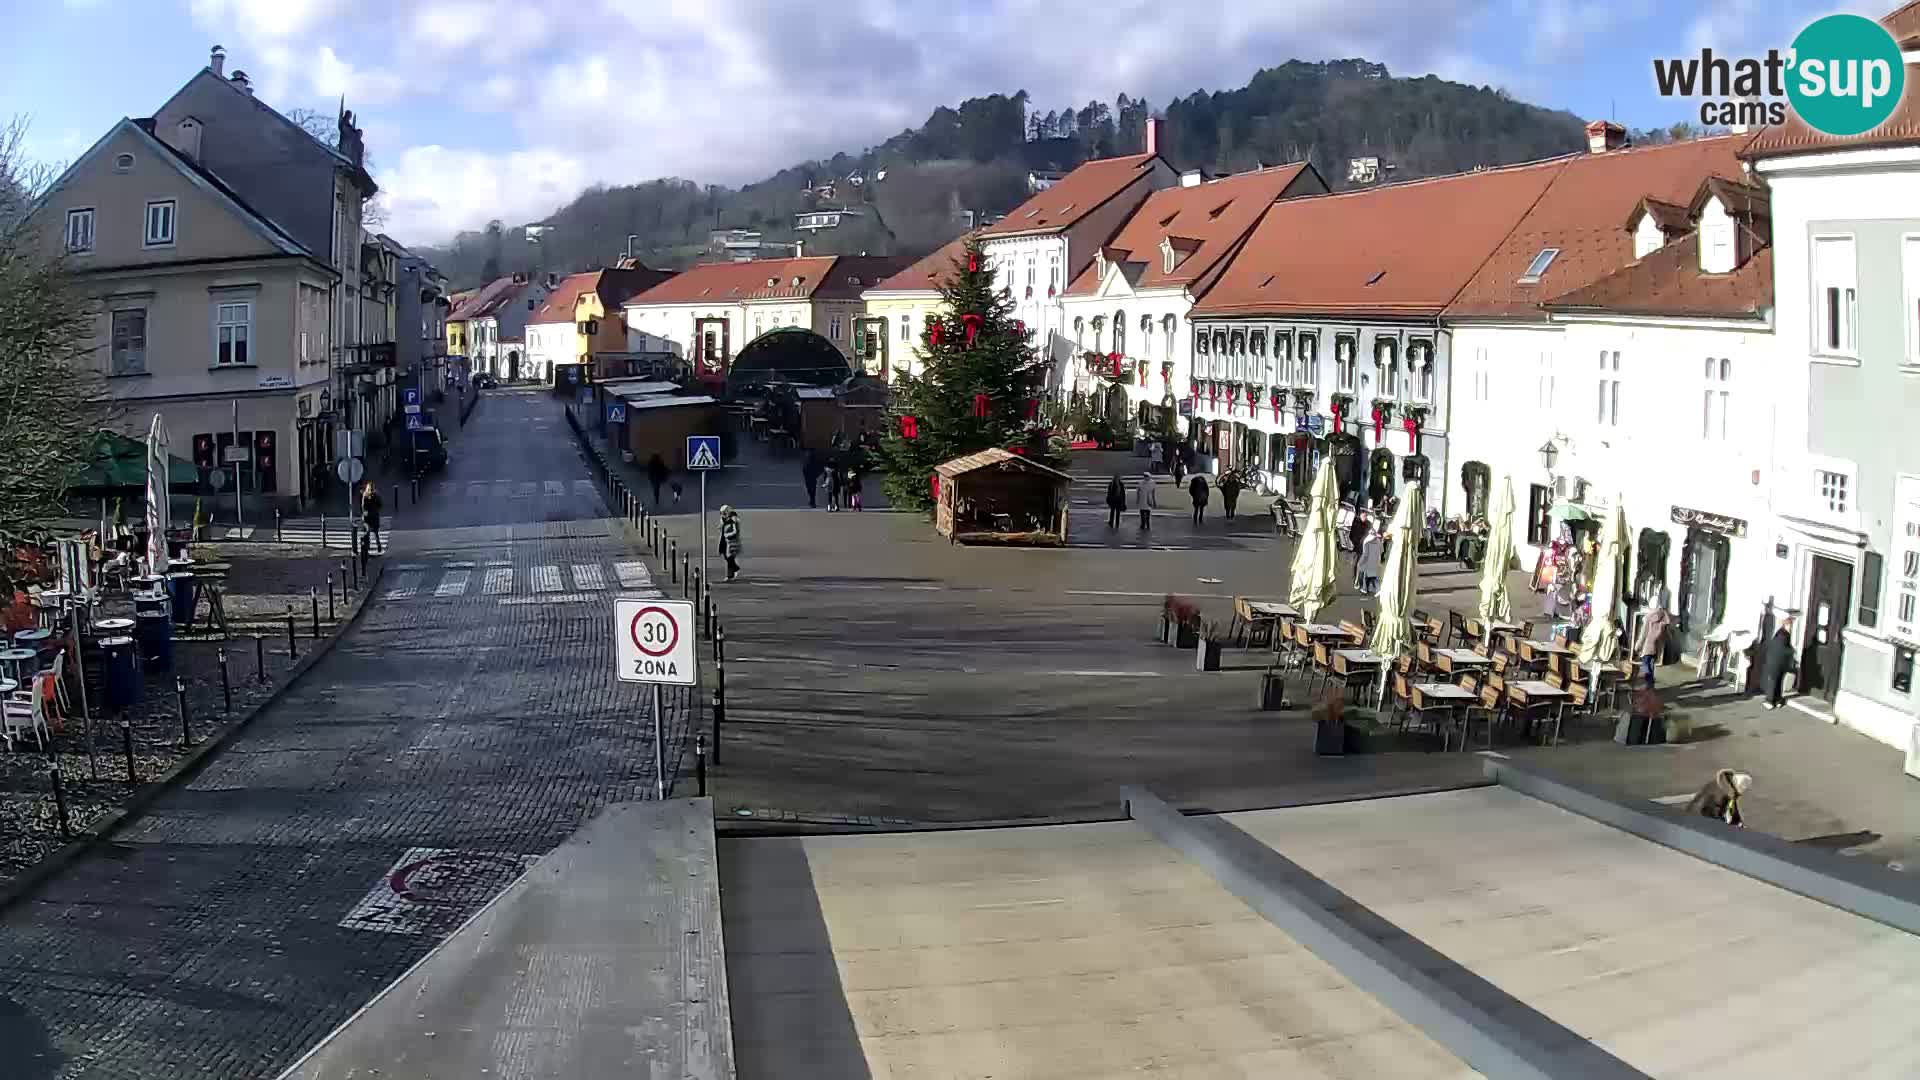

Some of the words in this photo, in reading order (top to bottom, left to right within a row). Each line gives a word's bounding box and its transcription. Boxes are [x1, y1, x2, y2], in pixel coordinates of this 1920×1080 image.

[408, 391, 416, 403] P
[643, 622, 667, 643] 30
[634, 660, 678, 676] ZONA
